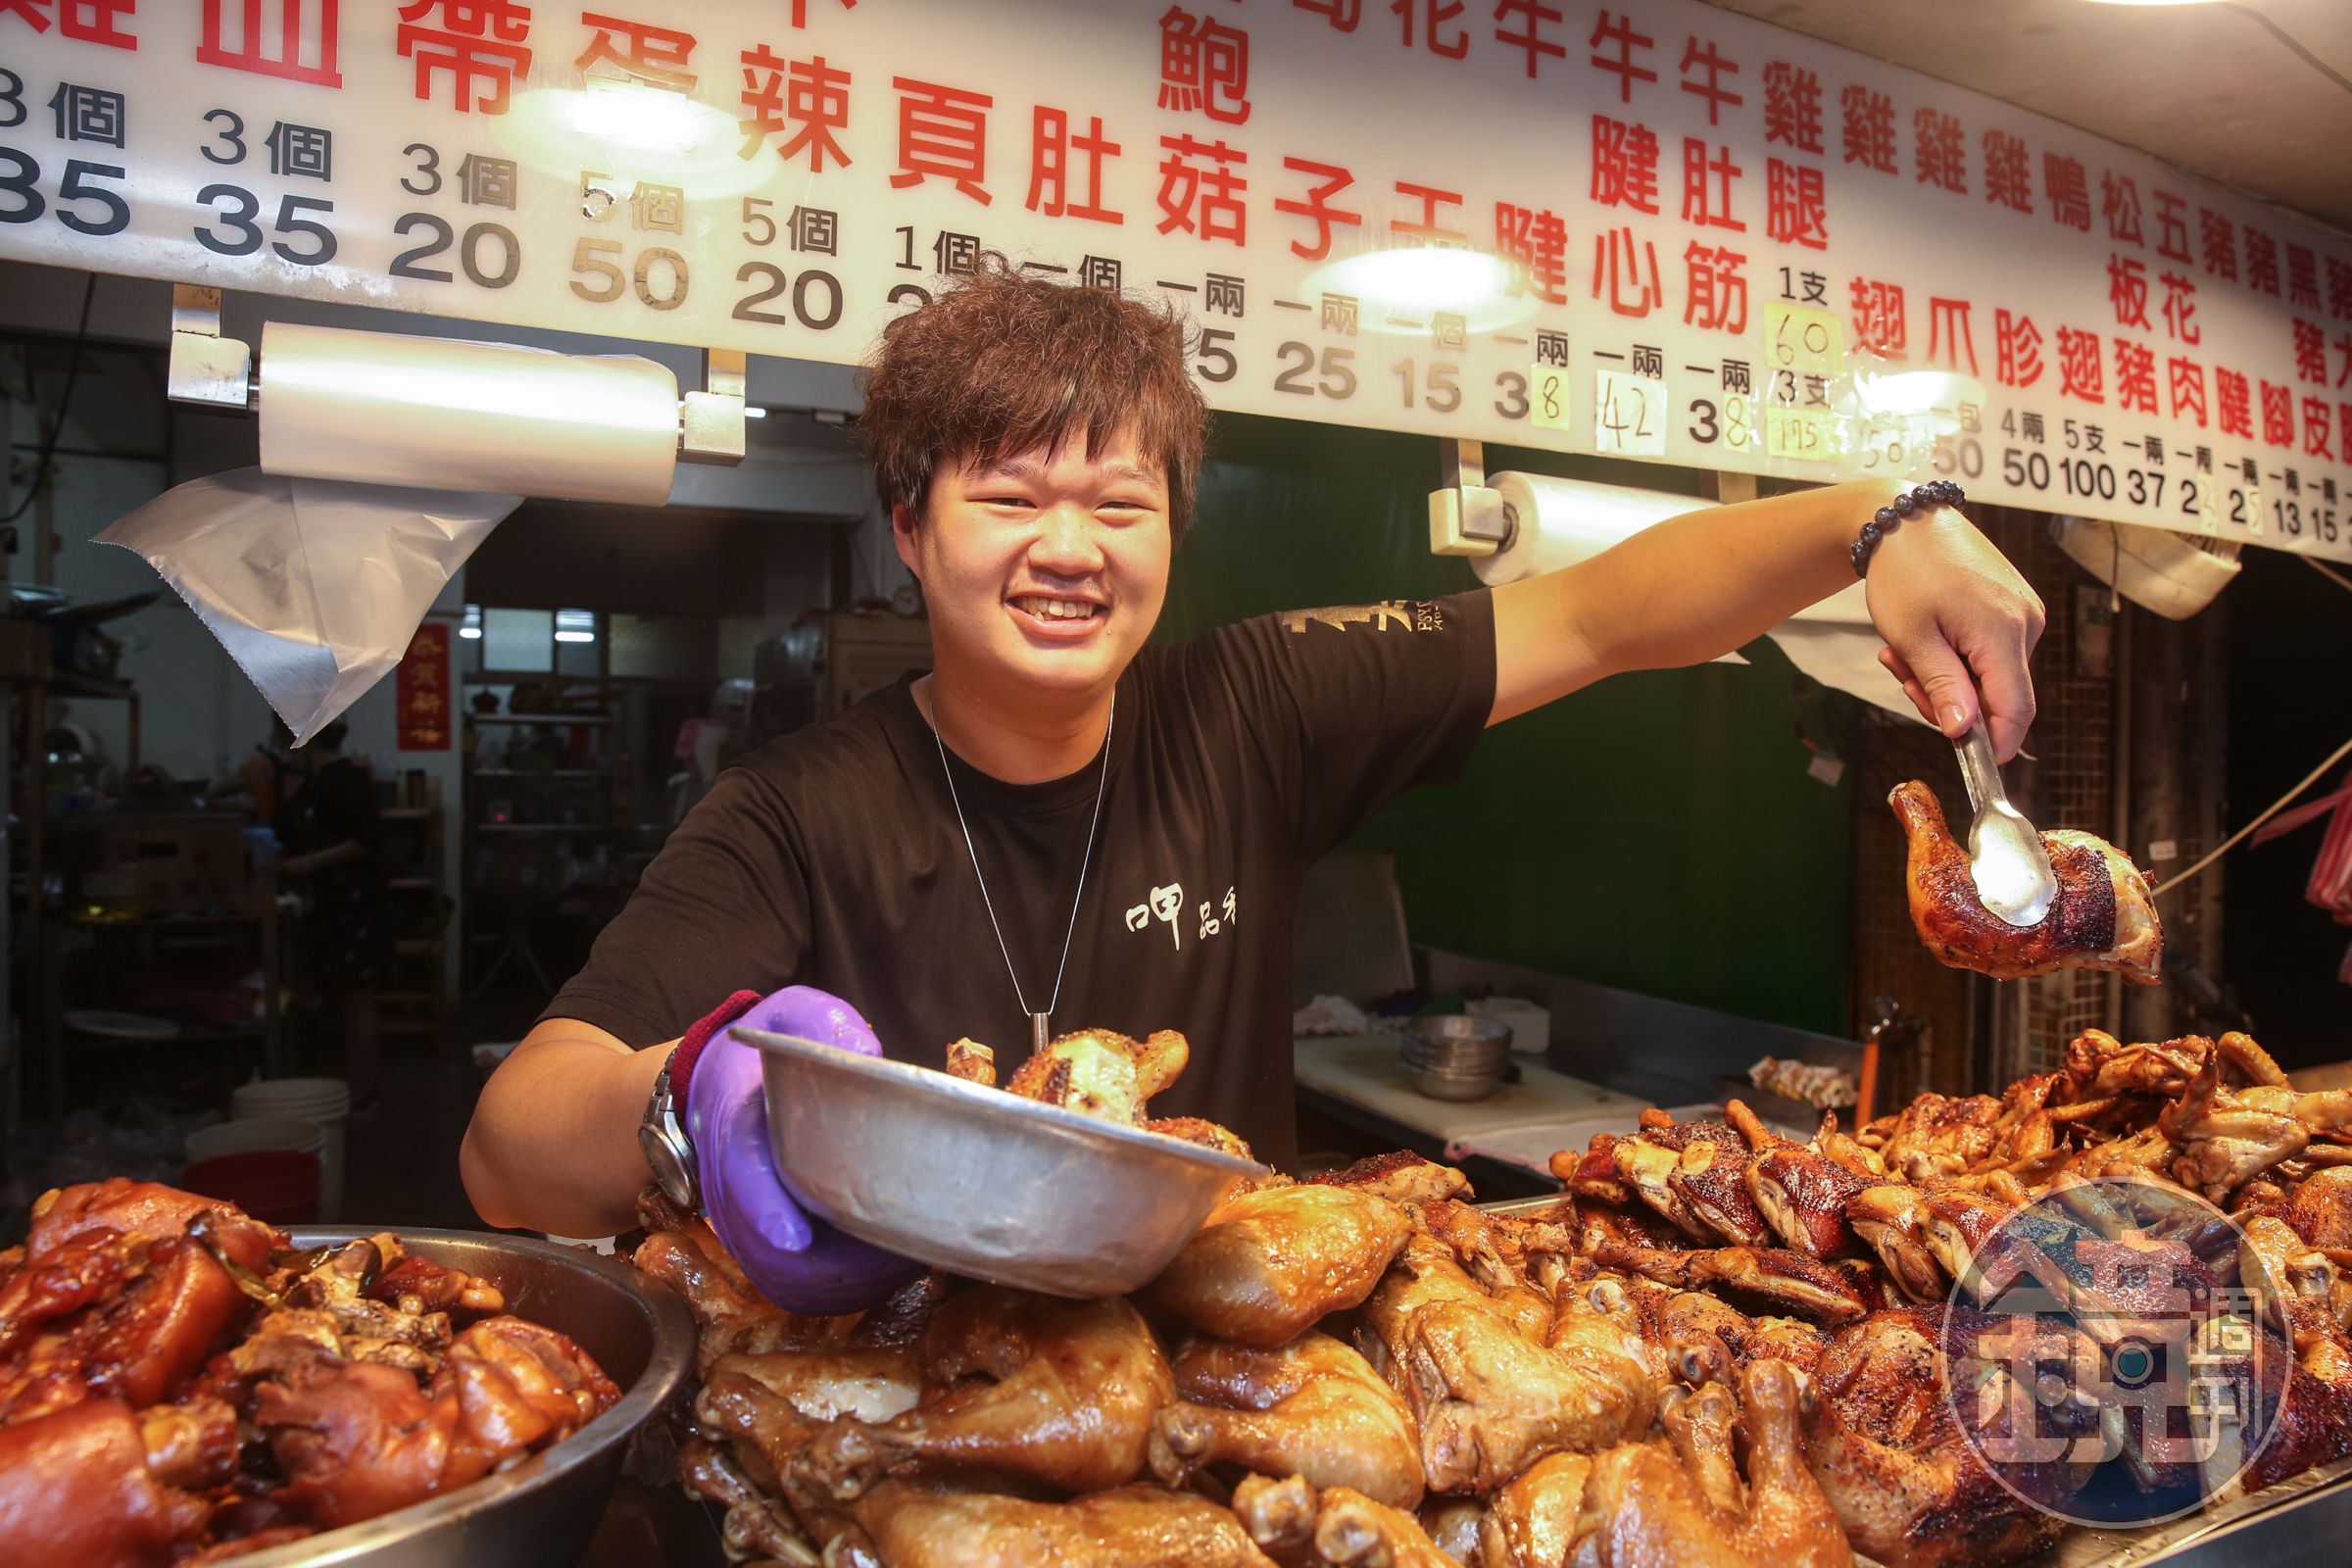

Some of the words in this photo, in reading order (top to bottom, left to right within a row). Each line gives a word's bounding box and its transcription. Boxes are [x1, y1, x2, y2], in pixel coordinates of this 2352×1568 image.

[200, 109, 332, 183] 3個
[889, 75, 993, 207] 頁
[1155, 4, 1251, 248] 鮑菇
[1761, 60, 1829, 252] 雞腿
[400, 143, 518, 212] 3個
[1025, 104, 1125, 225] 肚
[1589, 9, 1664, 318] 牛腱心
[1679, 35, 1748, 335] 牛肚筋
[194, 183, 338, 266] 35
[389, 212, 521, 289] 20
[742, 196, 838, 257] 5個
[568, 237, 689, 311] 50
[732, 261, 843, 330] 20
[1156, 272, 1245, 318] 一兩
[1779, 267, 1829, 306] 1支
[1274, 341, 1357, 400] 25
[1777, 314, 1830, 366] 60
[1393, 358, 1462, 413] 15
[1686, 359, 1750, 394] 一兩
[1602, 377, 1652, 448] 42
[2064, 418, 2107, 455] 5支
[1932, 434, 1984, 479] 50
[2004, 447, 2050, 491] 50
[2059, 457, 2117, 501] 100
[2127, 469, 2166, 509] 37
[2274, 499, 2302, 536] 13
[2311, 508, 2339, 543] 15
